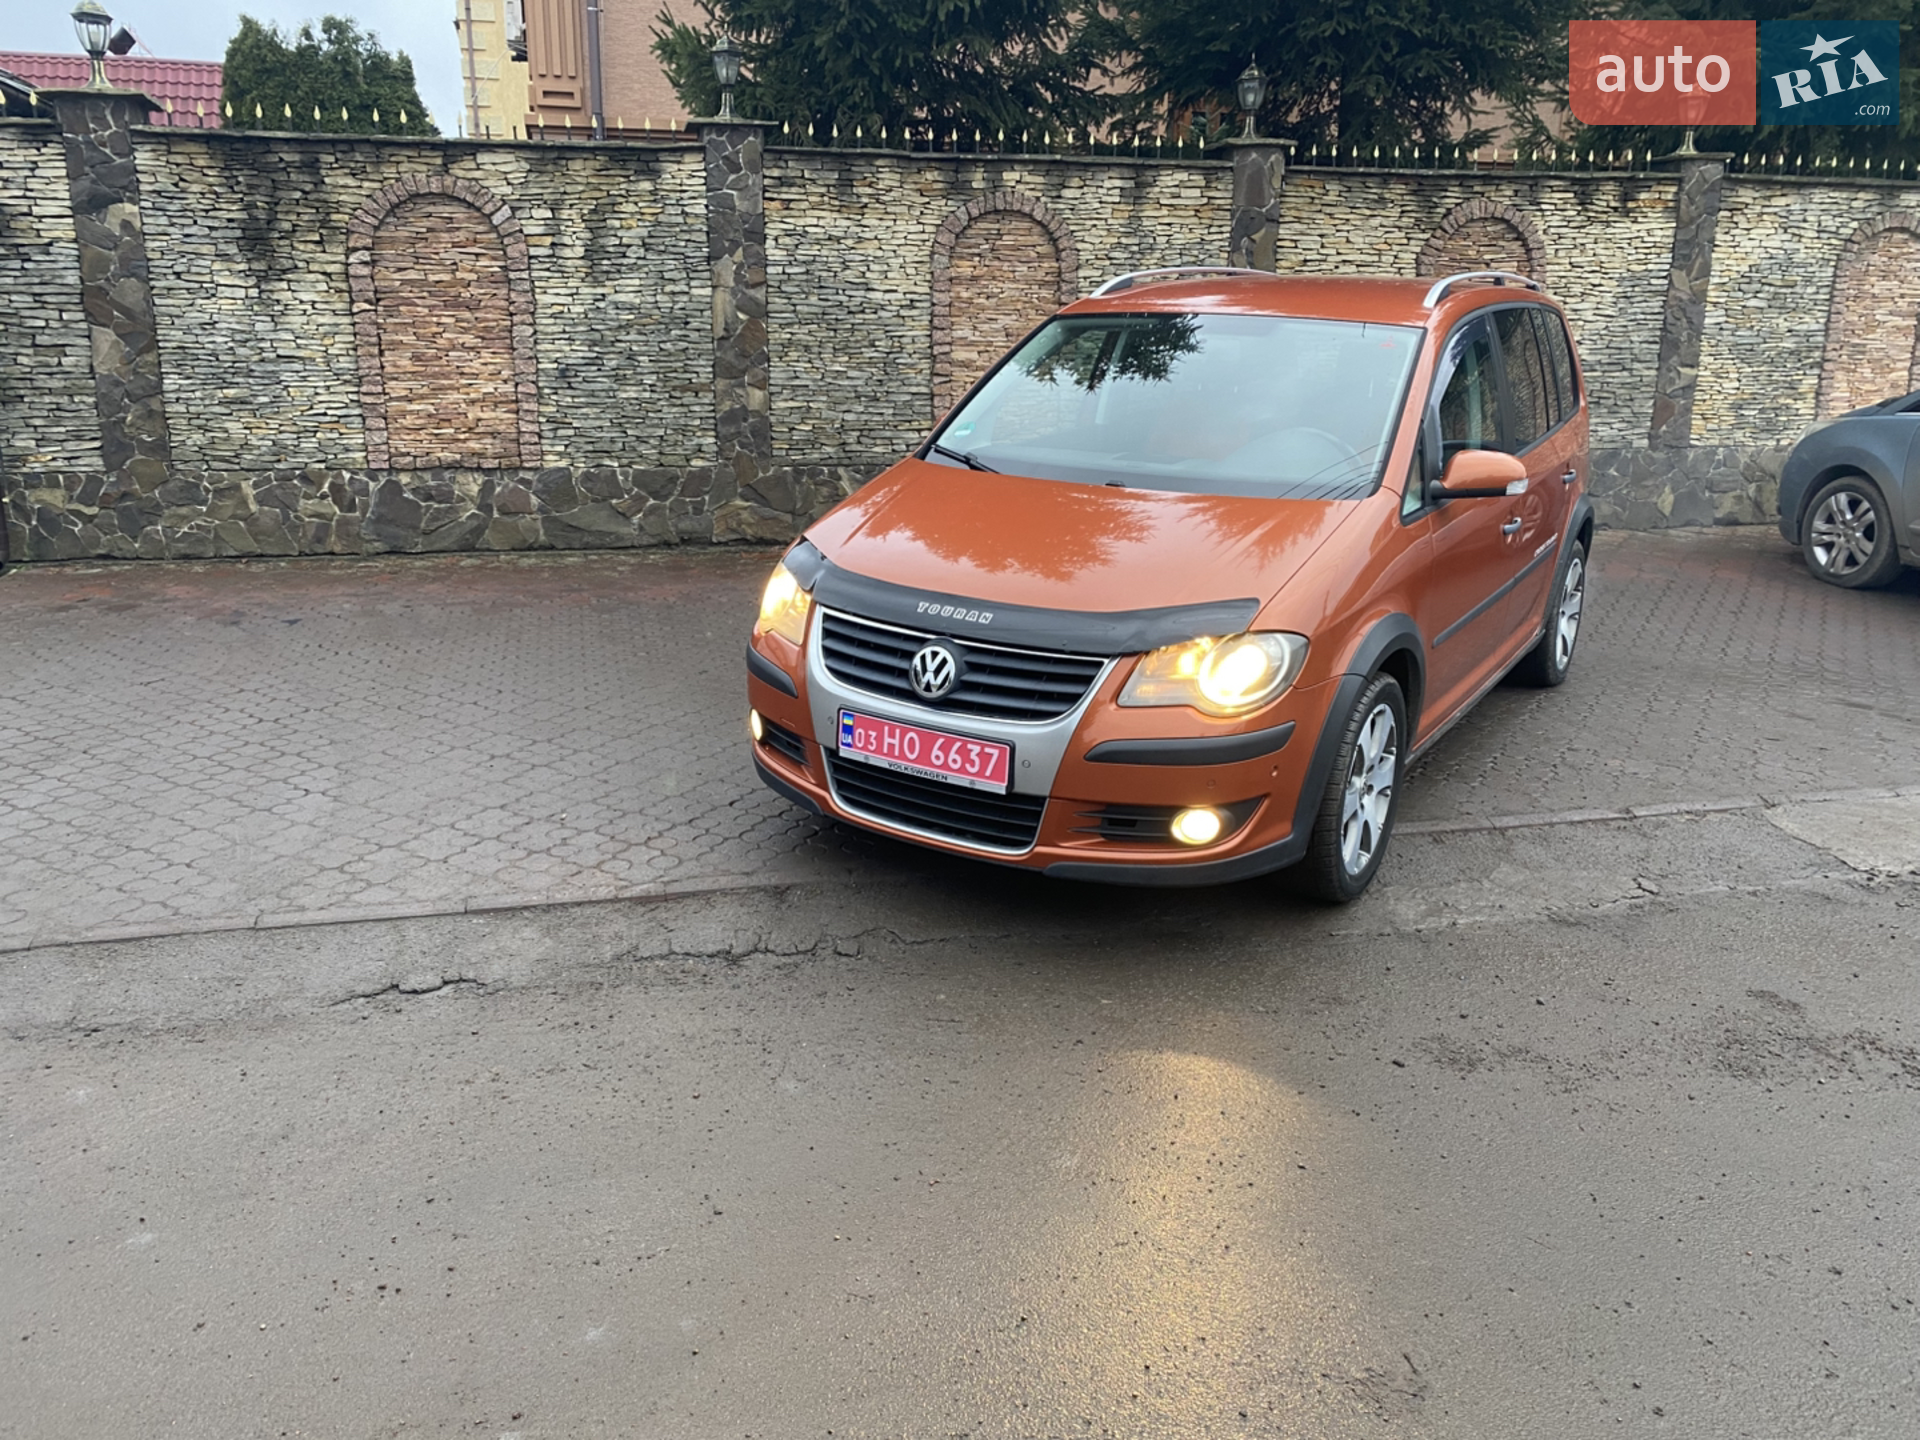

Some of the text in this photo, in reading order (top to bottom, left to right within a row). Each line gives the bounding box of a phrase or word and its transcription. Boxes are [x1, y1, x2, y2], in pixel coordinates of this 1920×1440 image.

[917, 601, 994, 624] TOURAN
[912, 646, 955, 698] VW
[842, 732, 853, 744] UA
[854, 725, 1000, 777] 03 HO 6637
[887, 761, 948, 782] VOLKSWAGEN
